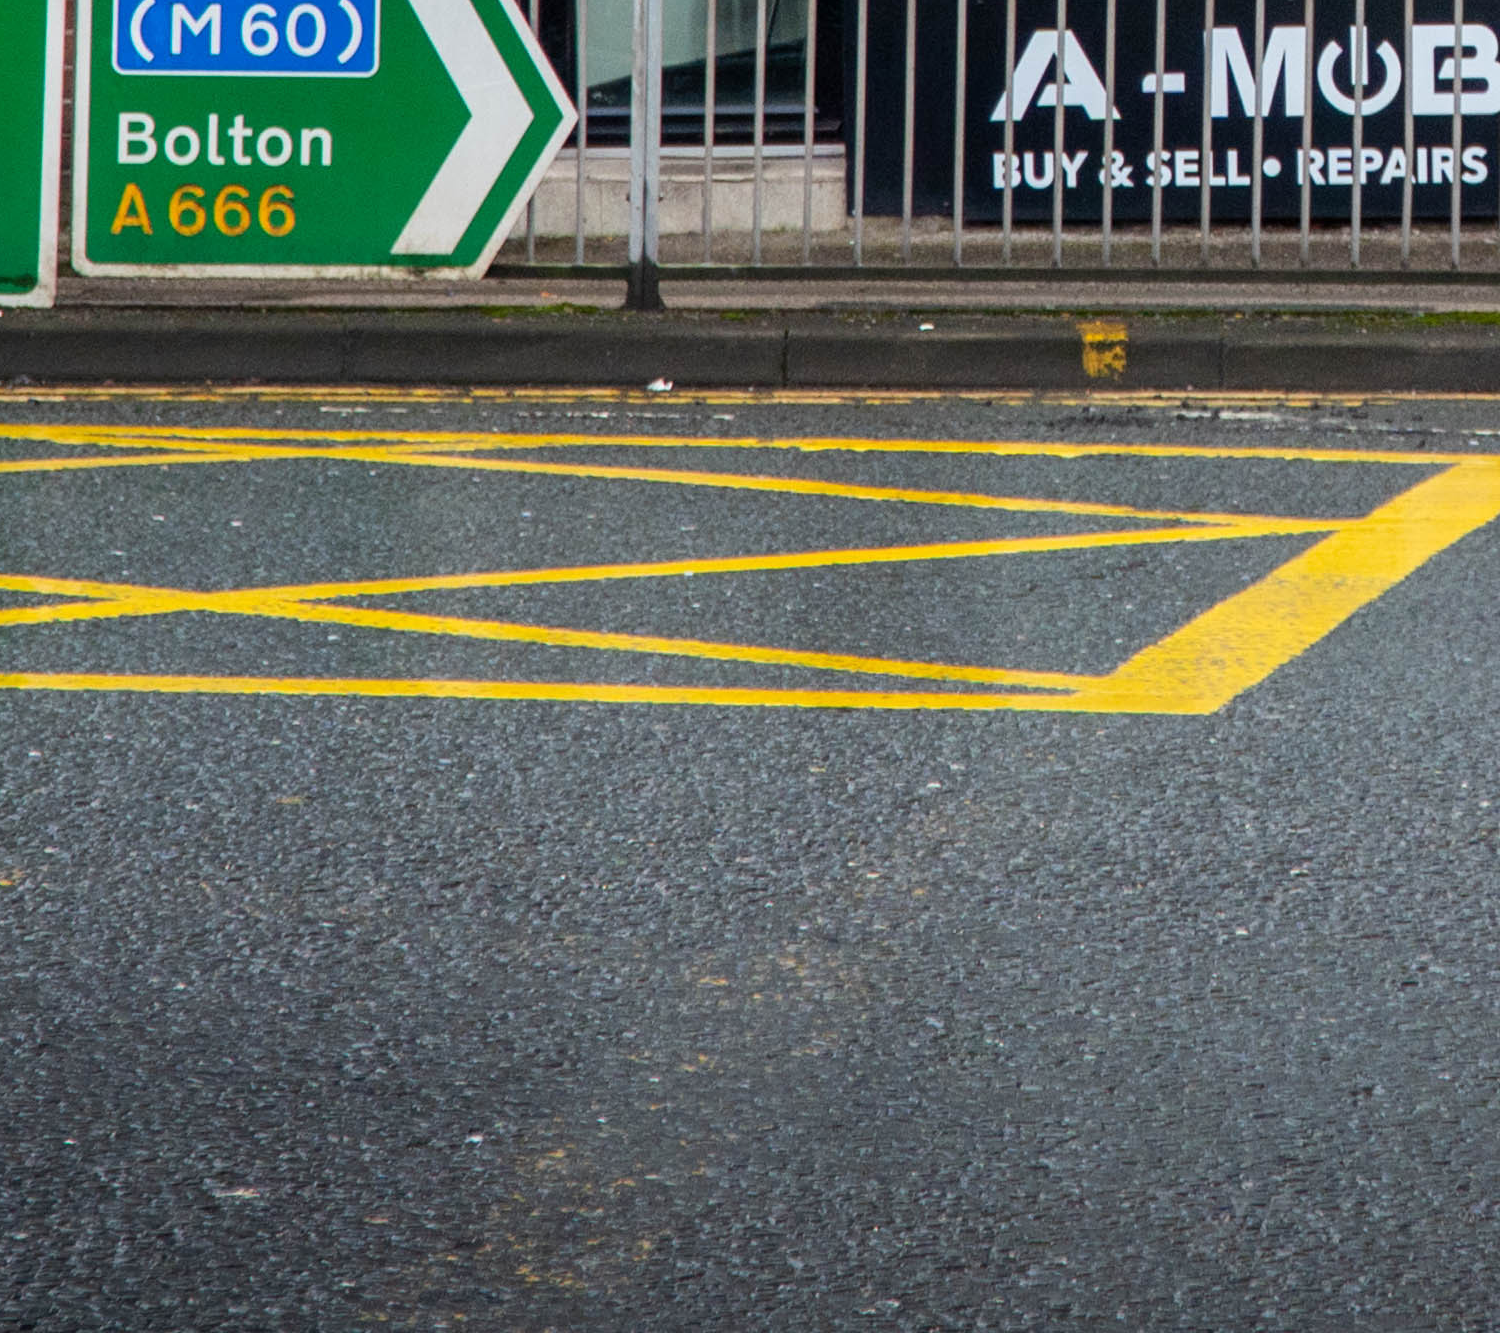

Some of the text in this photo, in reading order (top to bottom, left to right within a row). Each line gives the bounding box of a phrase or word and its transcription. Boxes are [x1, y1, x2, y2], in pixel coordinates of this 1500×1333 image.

[117, 111, 333, 167] Bolton
[992, 149, 1089, 190] BUY
[1145, 147, 1252, 188] SELL
[1296, 145, 1489, 186] REPAIRS
[110, 182, 297, 238] A 666
